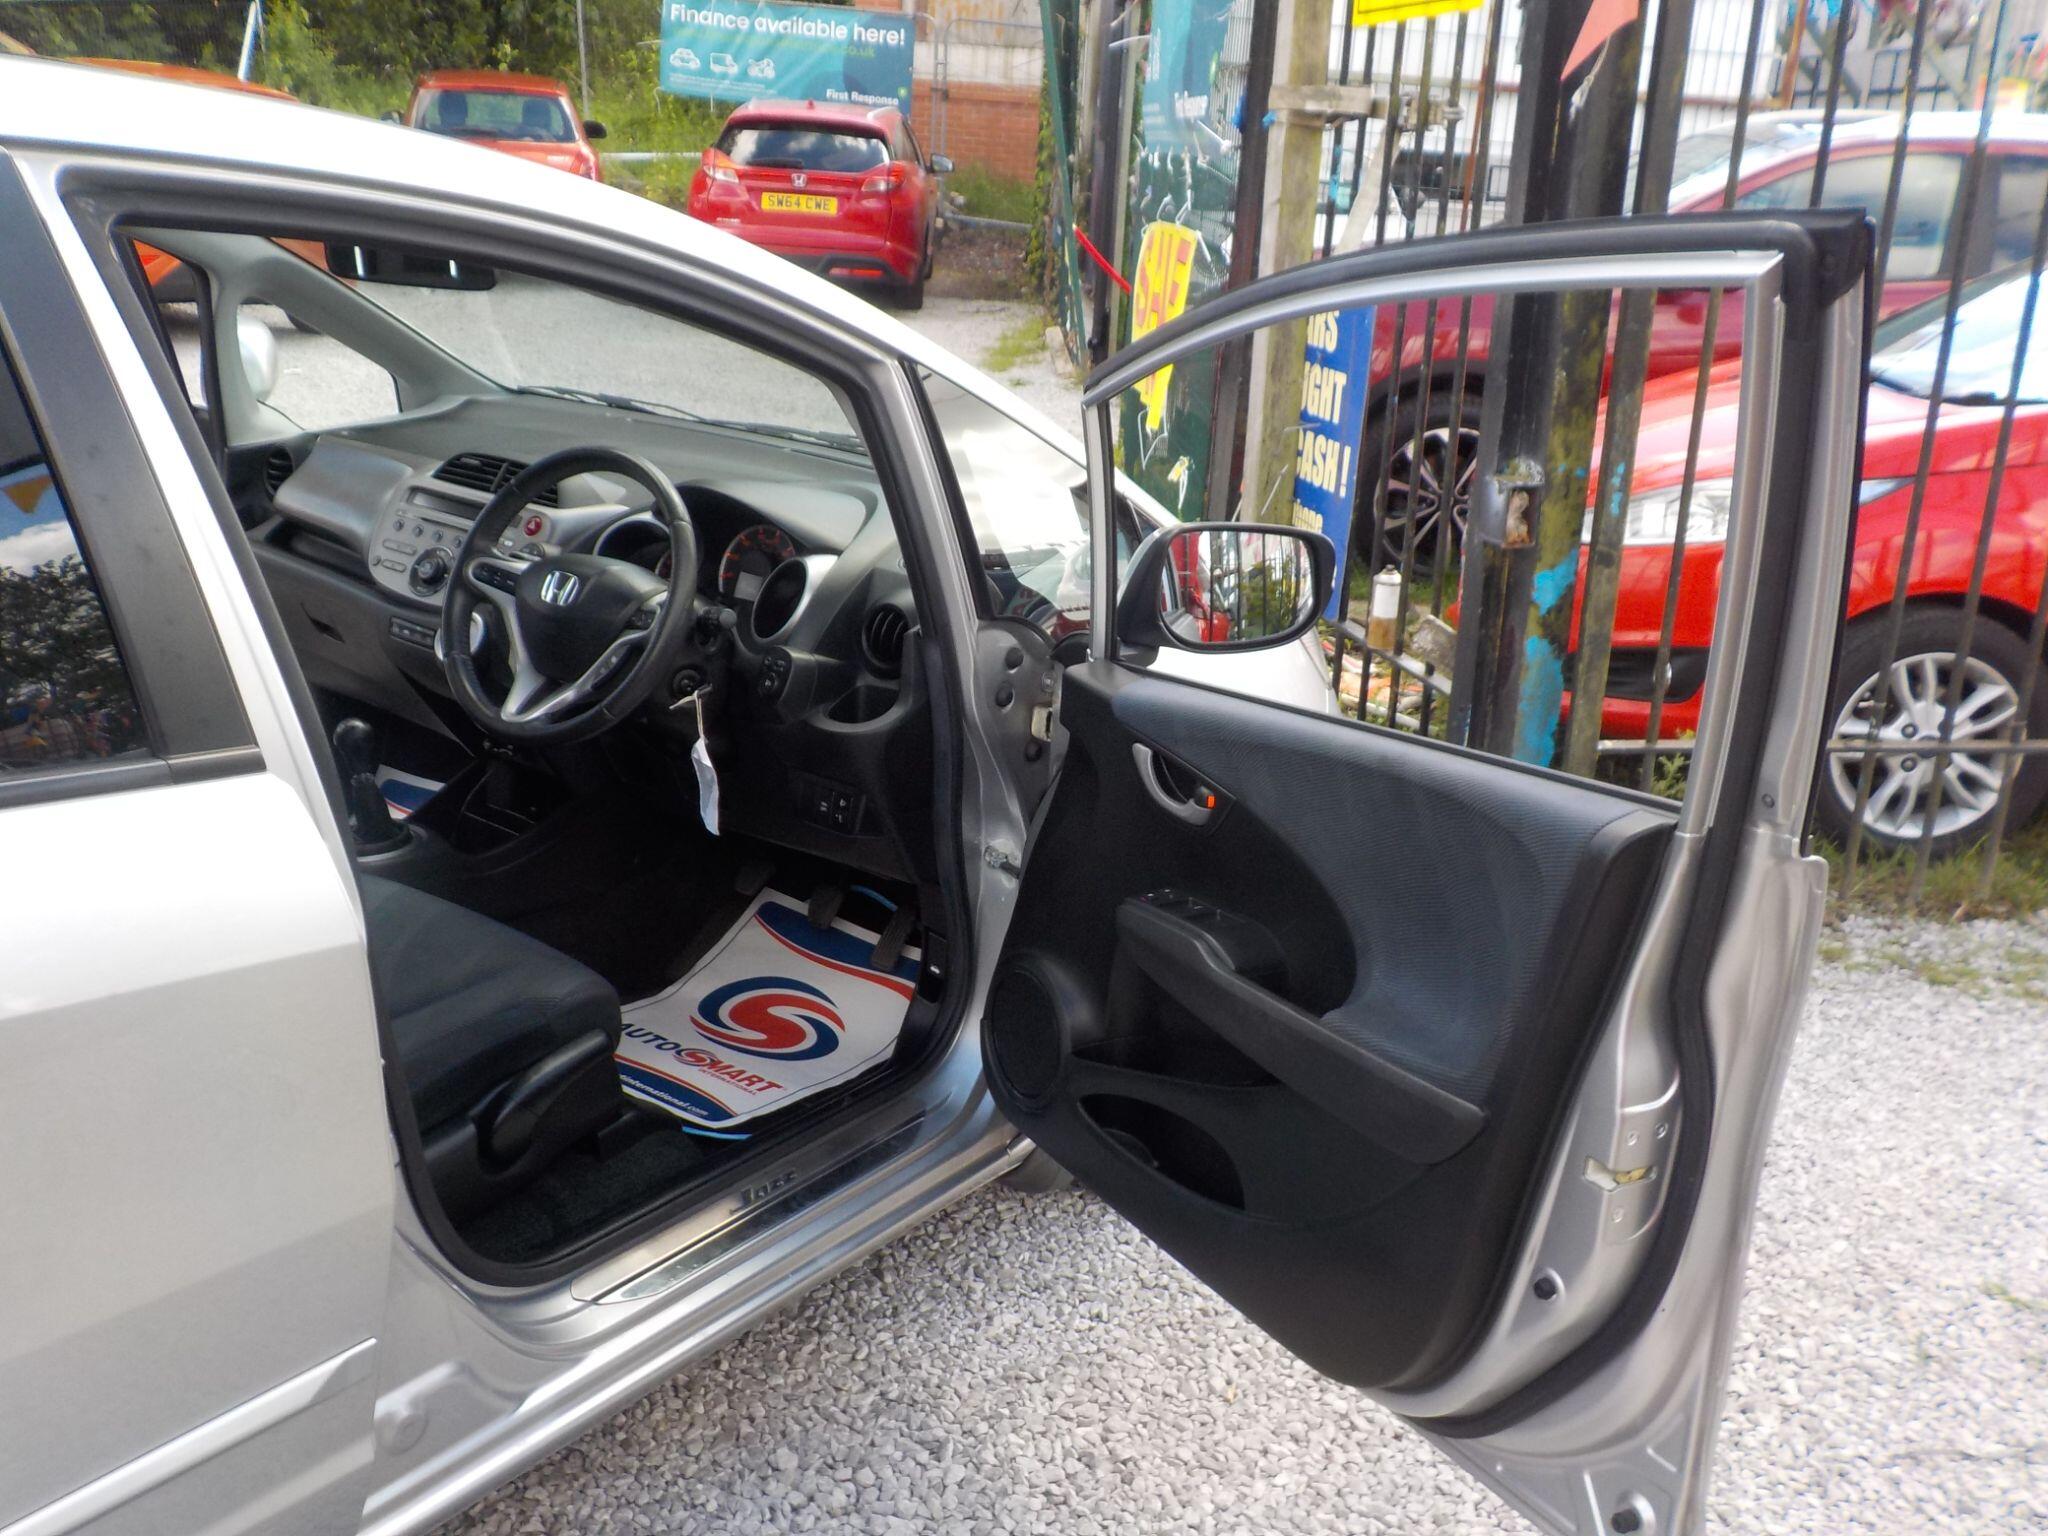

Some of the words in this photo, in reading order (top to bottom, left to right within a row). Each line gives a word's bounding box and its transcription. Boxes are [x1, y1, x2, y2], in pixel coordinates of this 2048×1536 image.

[670, 4, 750, 30] Finance
[754, 15, 848, 40] available
[853, 23, 905, 45] here!
[826, 88, 850, 101] First
[851, 91, 900, 106] Response
[768, 195, 801, 209] SW64
[1307, 310, 1340, 353] ARS
[1301, 361, 1347, 426] UGHT
